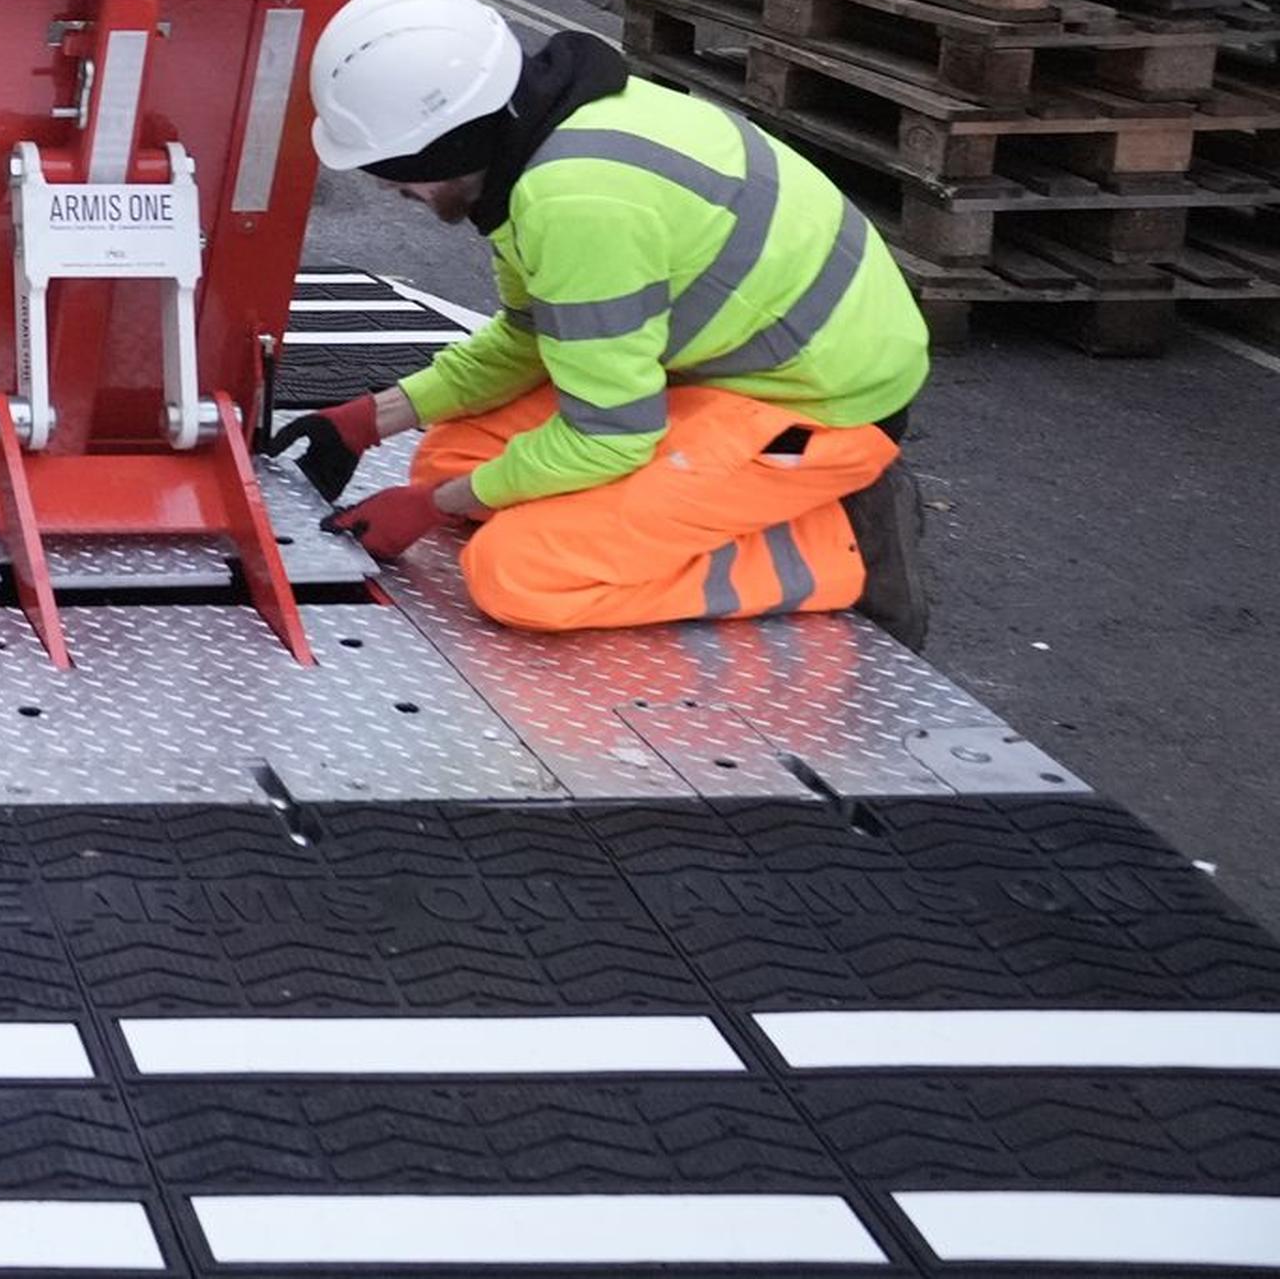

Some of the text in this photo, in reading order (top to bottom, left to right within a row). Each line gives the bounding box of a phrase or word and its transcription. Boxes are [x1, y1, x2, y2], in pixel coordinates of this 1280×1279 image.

[50, 194, 173, 222] ARMIS ONE
[75, 878, 635, 923] ARMIS ONE
[675, 872, 988, 915] ARMIS
